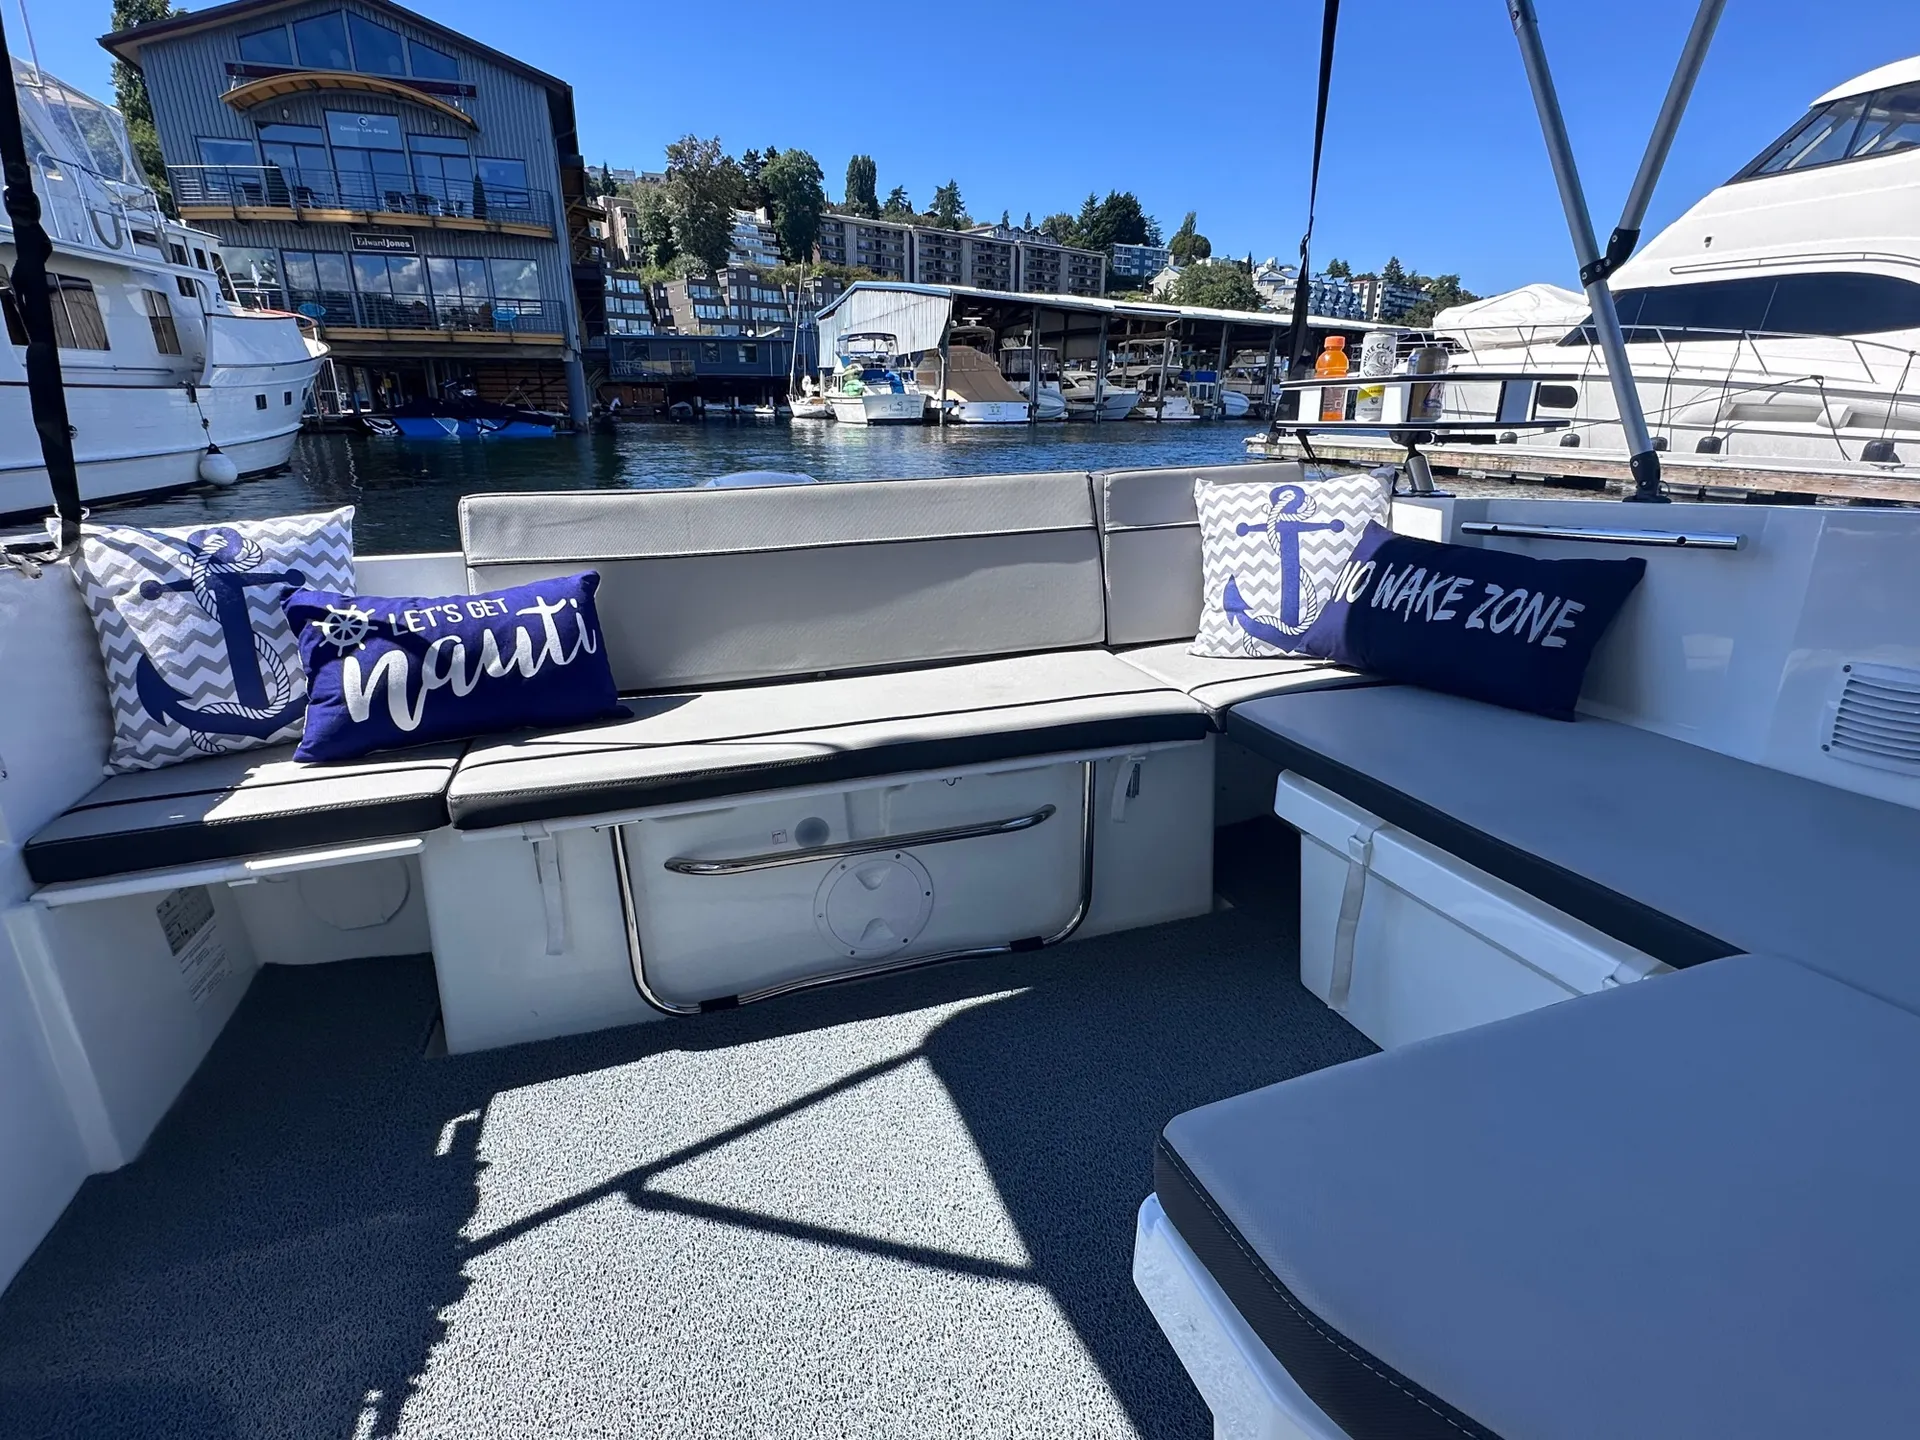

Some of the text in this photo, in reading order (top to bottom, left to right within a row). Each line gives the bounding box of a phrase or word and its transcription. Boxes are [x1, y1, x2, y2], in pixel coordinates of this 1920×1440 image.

[388, 597, 510, 636] LET'S GET
[1331, 560, 1586, 648] NO WAKE ZONE
[343, 596, 597, 731] nauti
